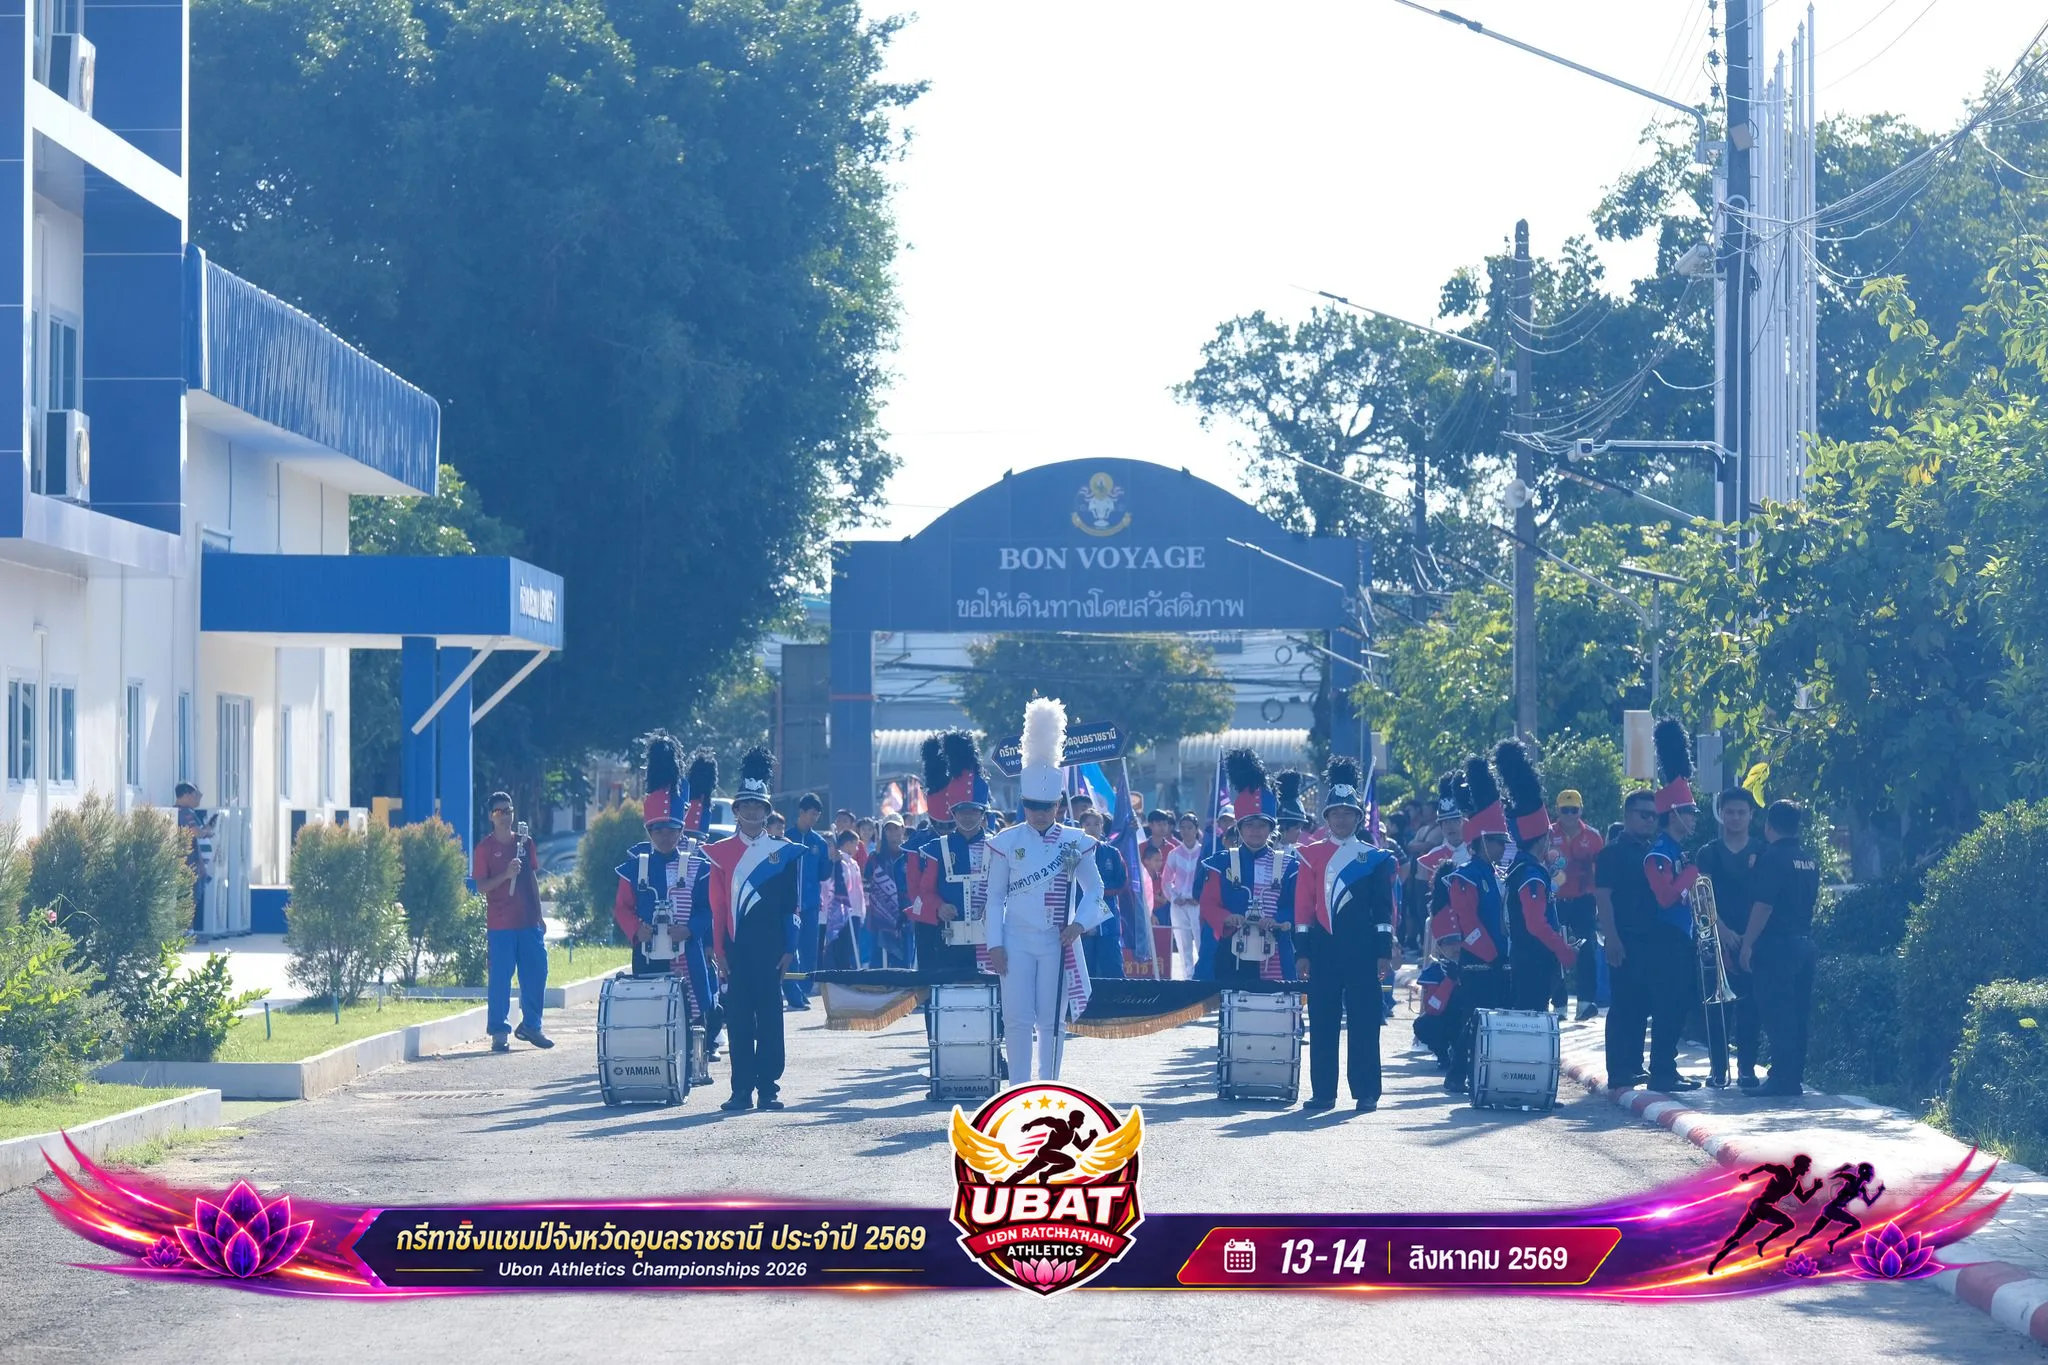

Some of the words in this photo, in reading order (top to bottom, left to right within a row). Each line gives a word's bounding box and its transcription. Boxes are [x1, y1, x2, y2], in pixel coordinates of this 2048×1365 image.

[999, 547, 1068, 570] BON
[1074, 546, 1206, 570] VOYAGE
[956, 587, 1245, 619] ขอให้เดินทางโดยสวัสดิภาพ
[1064, 743, 1116, 757] CHAMPIONSHIPS
[1041, 867, 1049, 878] 2
[624, 1066, 661, 1076] YAMAHA
[1509, 1072, 1536, 1081] YAMAHA
[953, 1084, 989, 1093] YAMAHA
